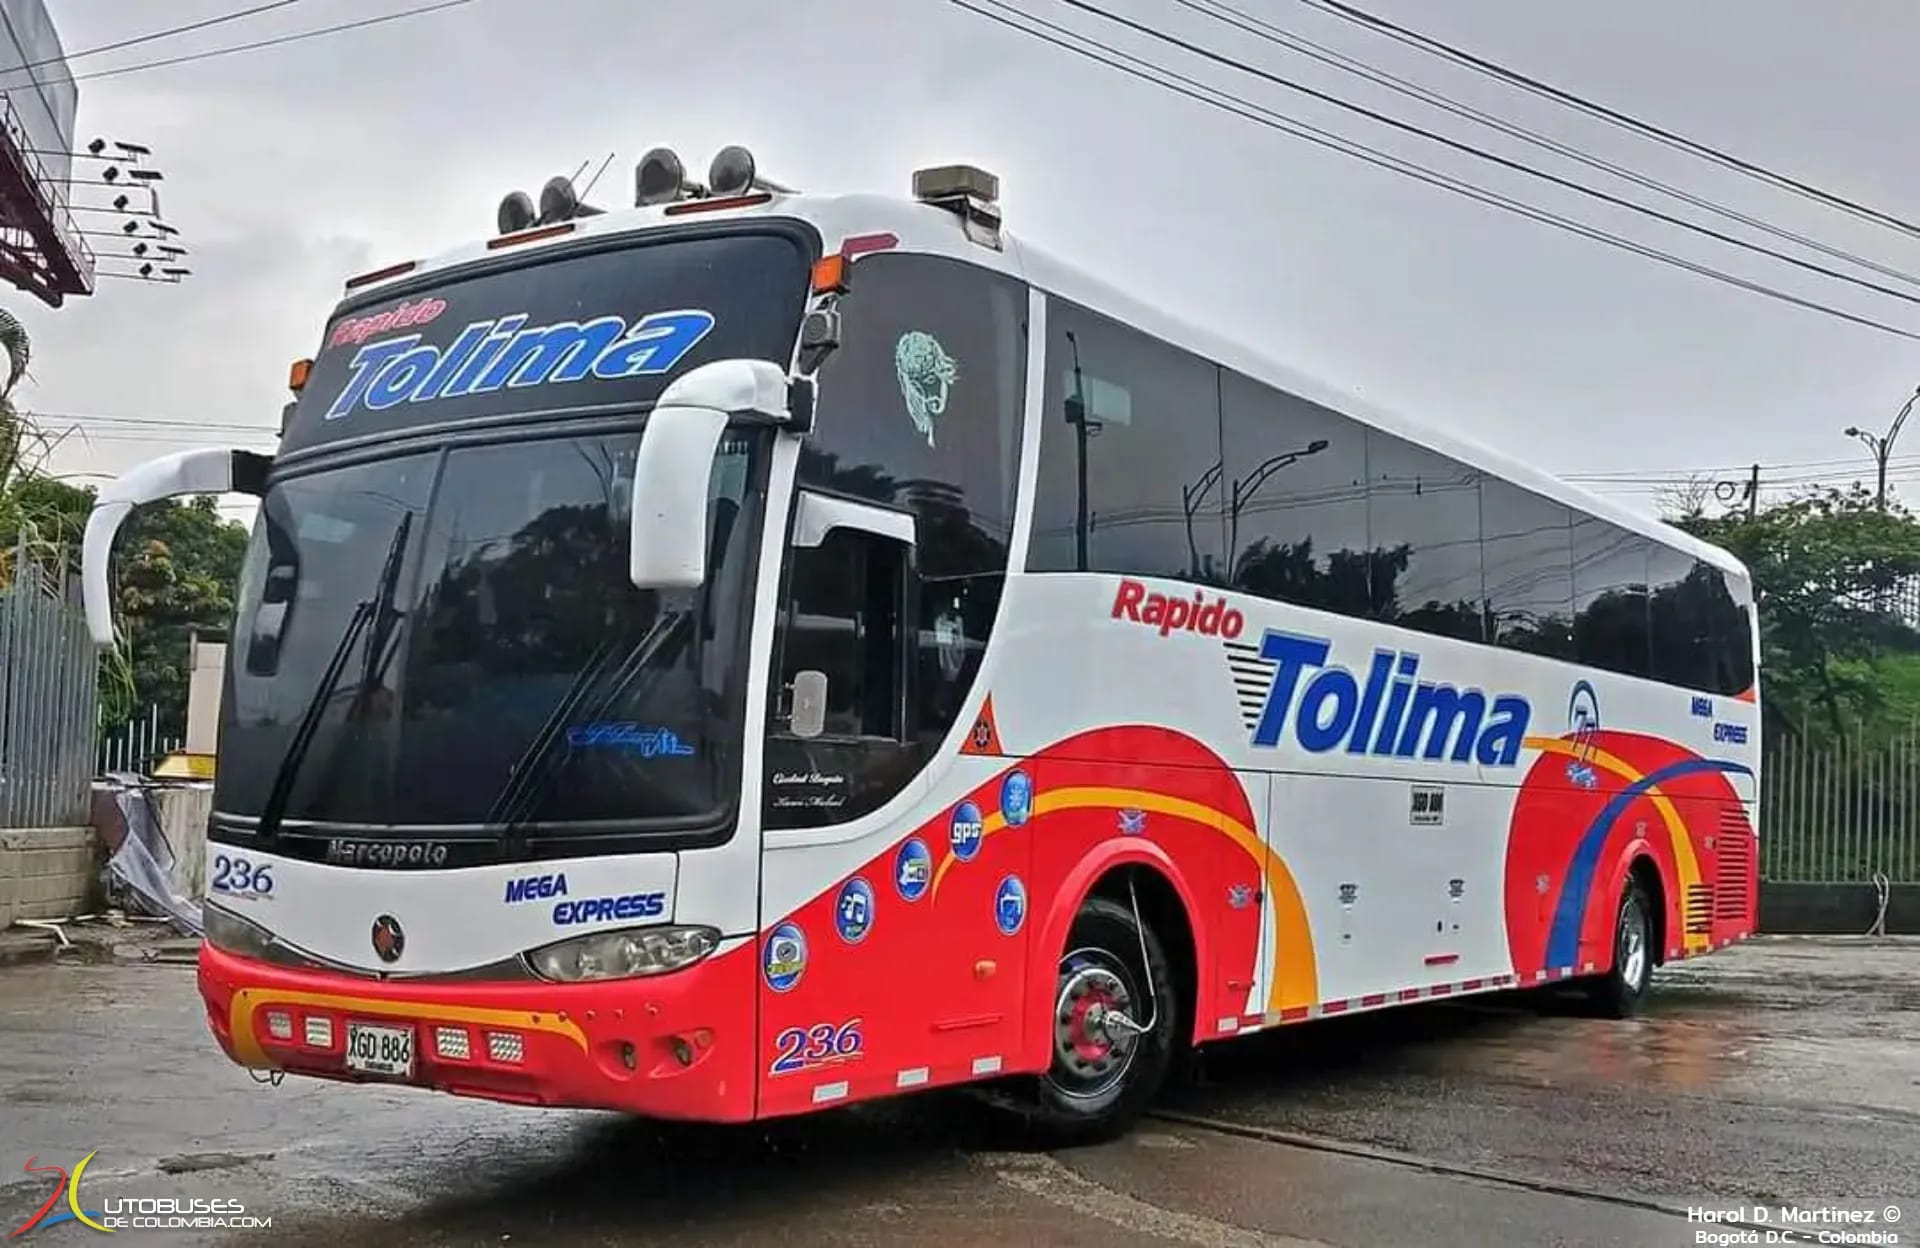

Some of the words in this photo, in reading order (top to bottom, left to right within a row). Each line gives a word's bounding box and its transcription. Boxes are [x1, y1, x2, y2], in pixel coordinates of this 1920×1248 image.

[328, 298, 447, 348] Rapido
[325, 310, 716, 420] Tolima
[1111, 577, 1244, 639] Rapido
[1251, 627, 1532, 767] Tolima
[328, 839, 448, 865] Marcopolo
[951, 822, 982, 844] gps
[212, 855, 273, 894] 236
[505, 873, 568, 903] MEGA
[553, 892, 665, 925] EXPRESS
[348, 1028, 376, 1060] XGD
[381, 1034, 410, 1063] 886
[770, 1018, 863, 1075] 236
